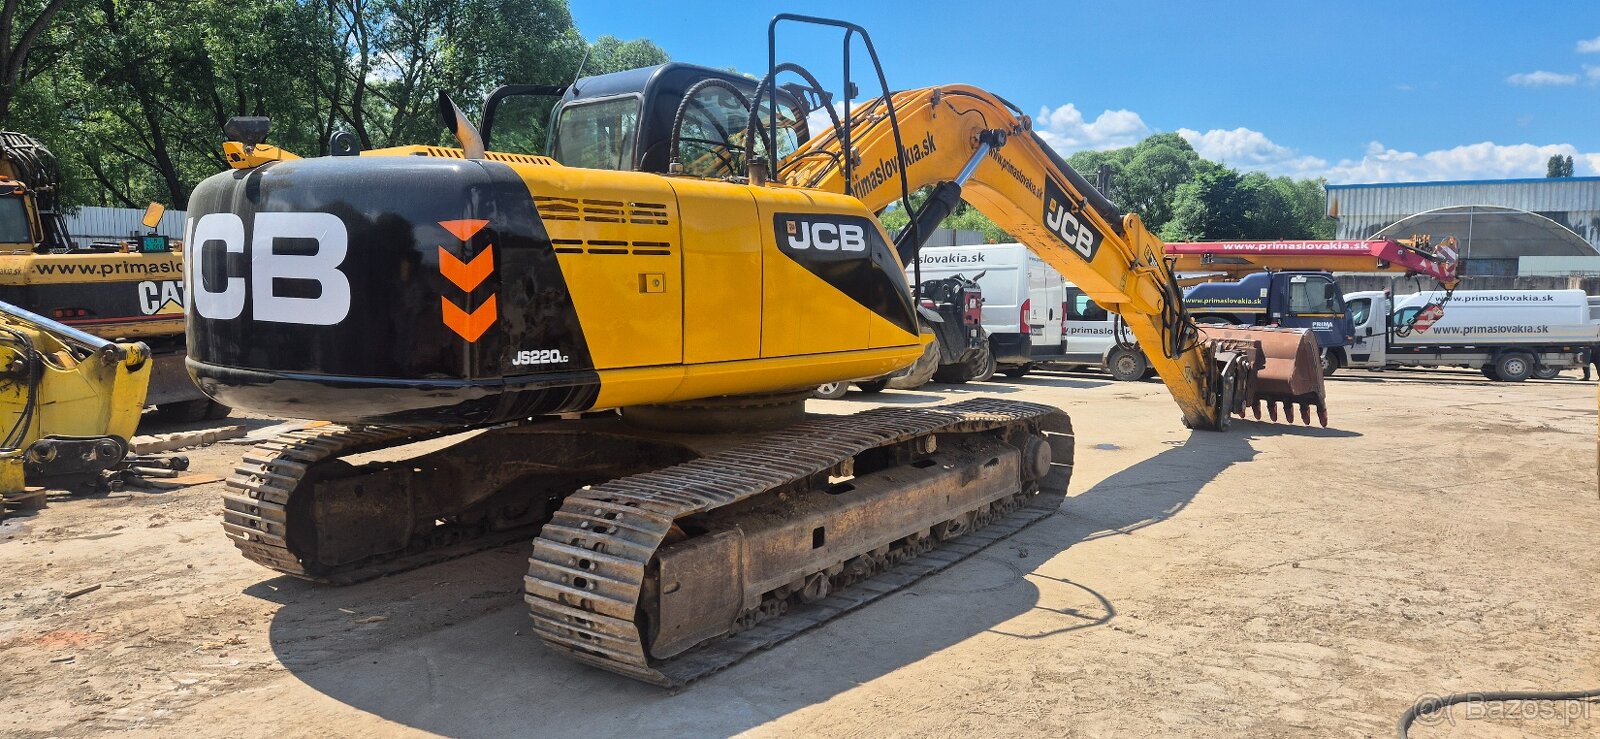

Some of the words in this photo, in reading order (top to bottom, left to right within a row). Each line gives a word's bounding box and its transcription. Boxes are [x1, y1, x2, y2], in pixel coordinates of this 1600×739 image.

[788, 222, 866, 251] JCB
[1047, 205, 1094, 257] JCB
[1223, 241, 1369, 251] www.primaslovakia.sk
[1186, 297, 1262, 305] www.primaslovakia.sk
[1433, 324, 1549, 336] www.primaslovakia.sk
